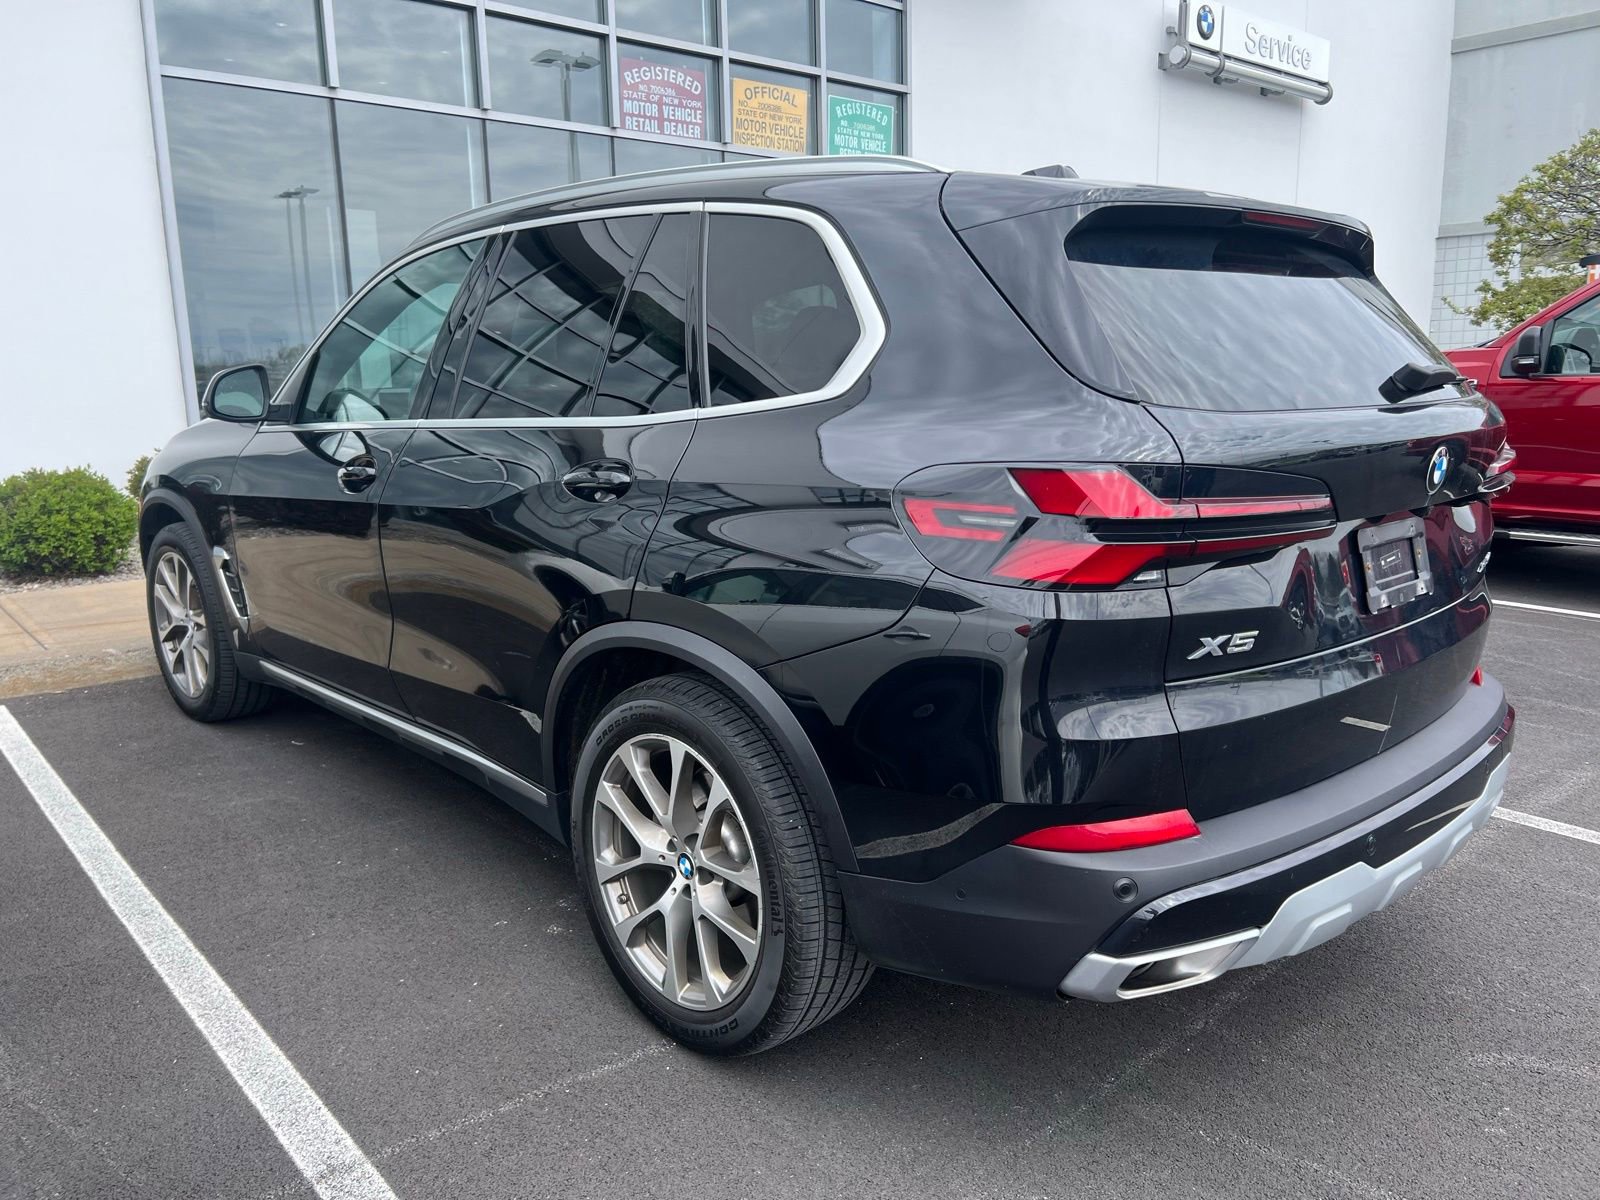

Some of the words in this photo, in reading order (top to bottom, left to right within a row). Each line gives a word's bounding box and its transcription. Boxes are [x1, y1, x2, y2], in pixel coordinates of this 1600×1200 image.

[1244, 22, 1312, 71] Service
[624, 66, 702, 95] REGISTERED
[623, 90, 647, 100] STATE
[650, 94, 660, 103] OF
[663, 96, 679, 105] NEW
[682, 98, 702, 109] YORK
[744, 86, 798, 108] OFFICIAL
[624, 99, 659, 118] MOTOR
[663, 105, 703, 123] VEHICLE
[737, 108, 758, 118] STATE
[759, 111, 768, 120] OF
[769, 113, 784, 121] NEW
[785, 115, 802, 125] YORK
[835, 102, 888, 126] REGISTERED
[625, 116, 661, 133] RETAIL
[664, 121, 701, 139] DEALER
[736, 117, 767, 134] MOTOR
[768, 122, 804, 139] VEHICLE
[837, 126, 852, 136] STATE
[860, 130, 871, 138] NEW
[871, 132, 884, 140] YORK
[735, 131, 775, 149] INSPECTION
[776, 137, 804, 153] STATION
[834, 133, 858, 149] MOTOR
[860, 138, 887, 153] VEHICLE
[1186, 630, 1260, 660] X5
